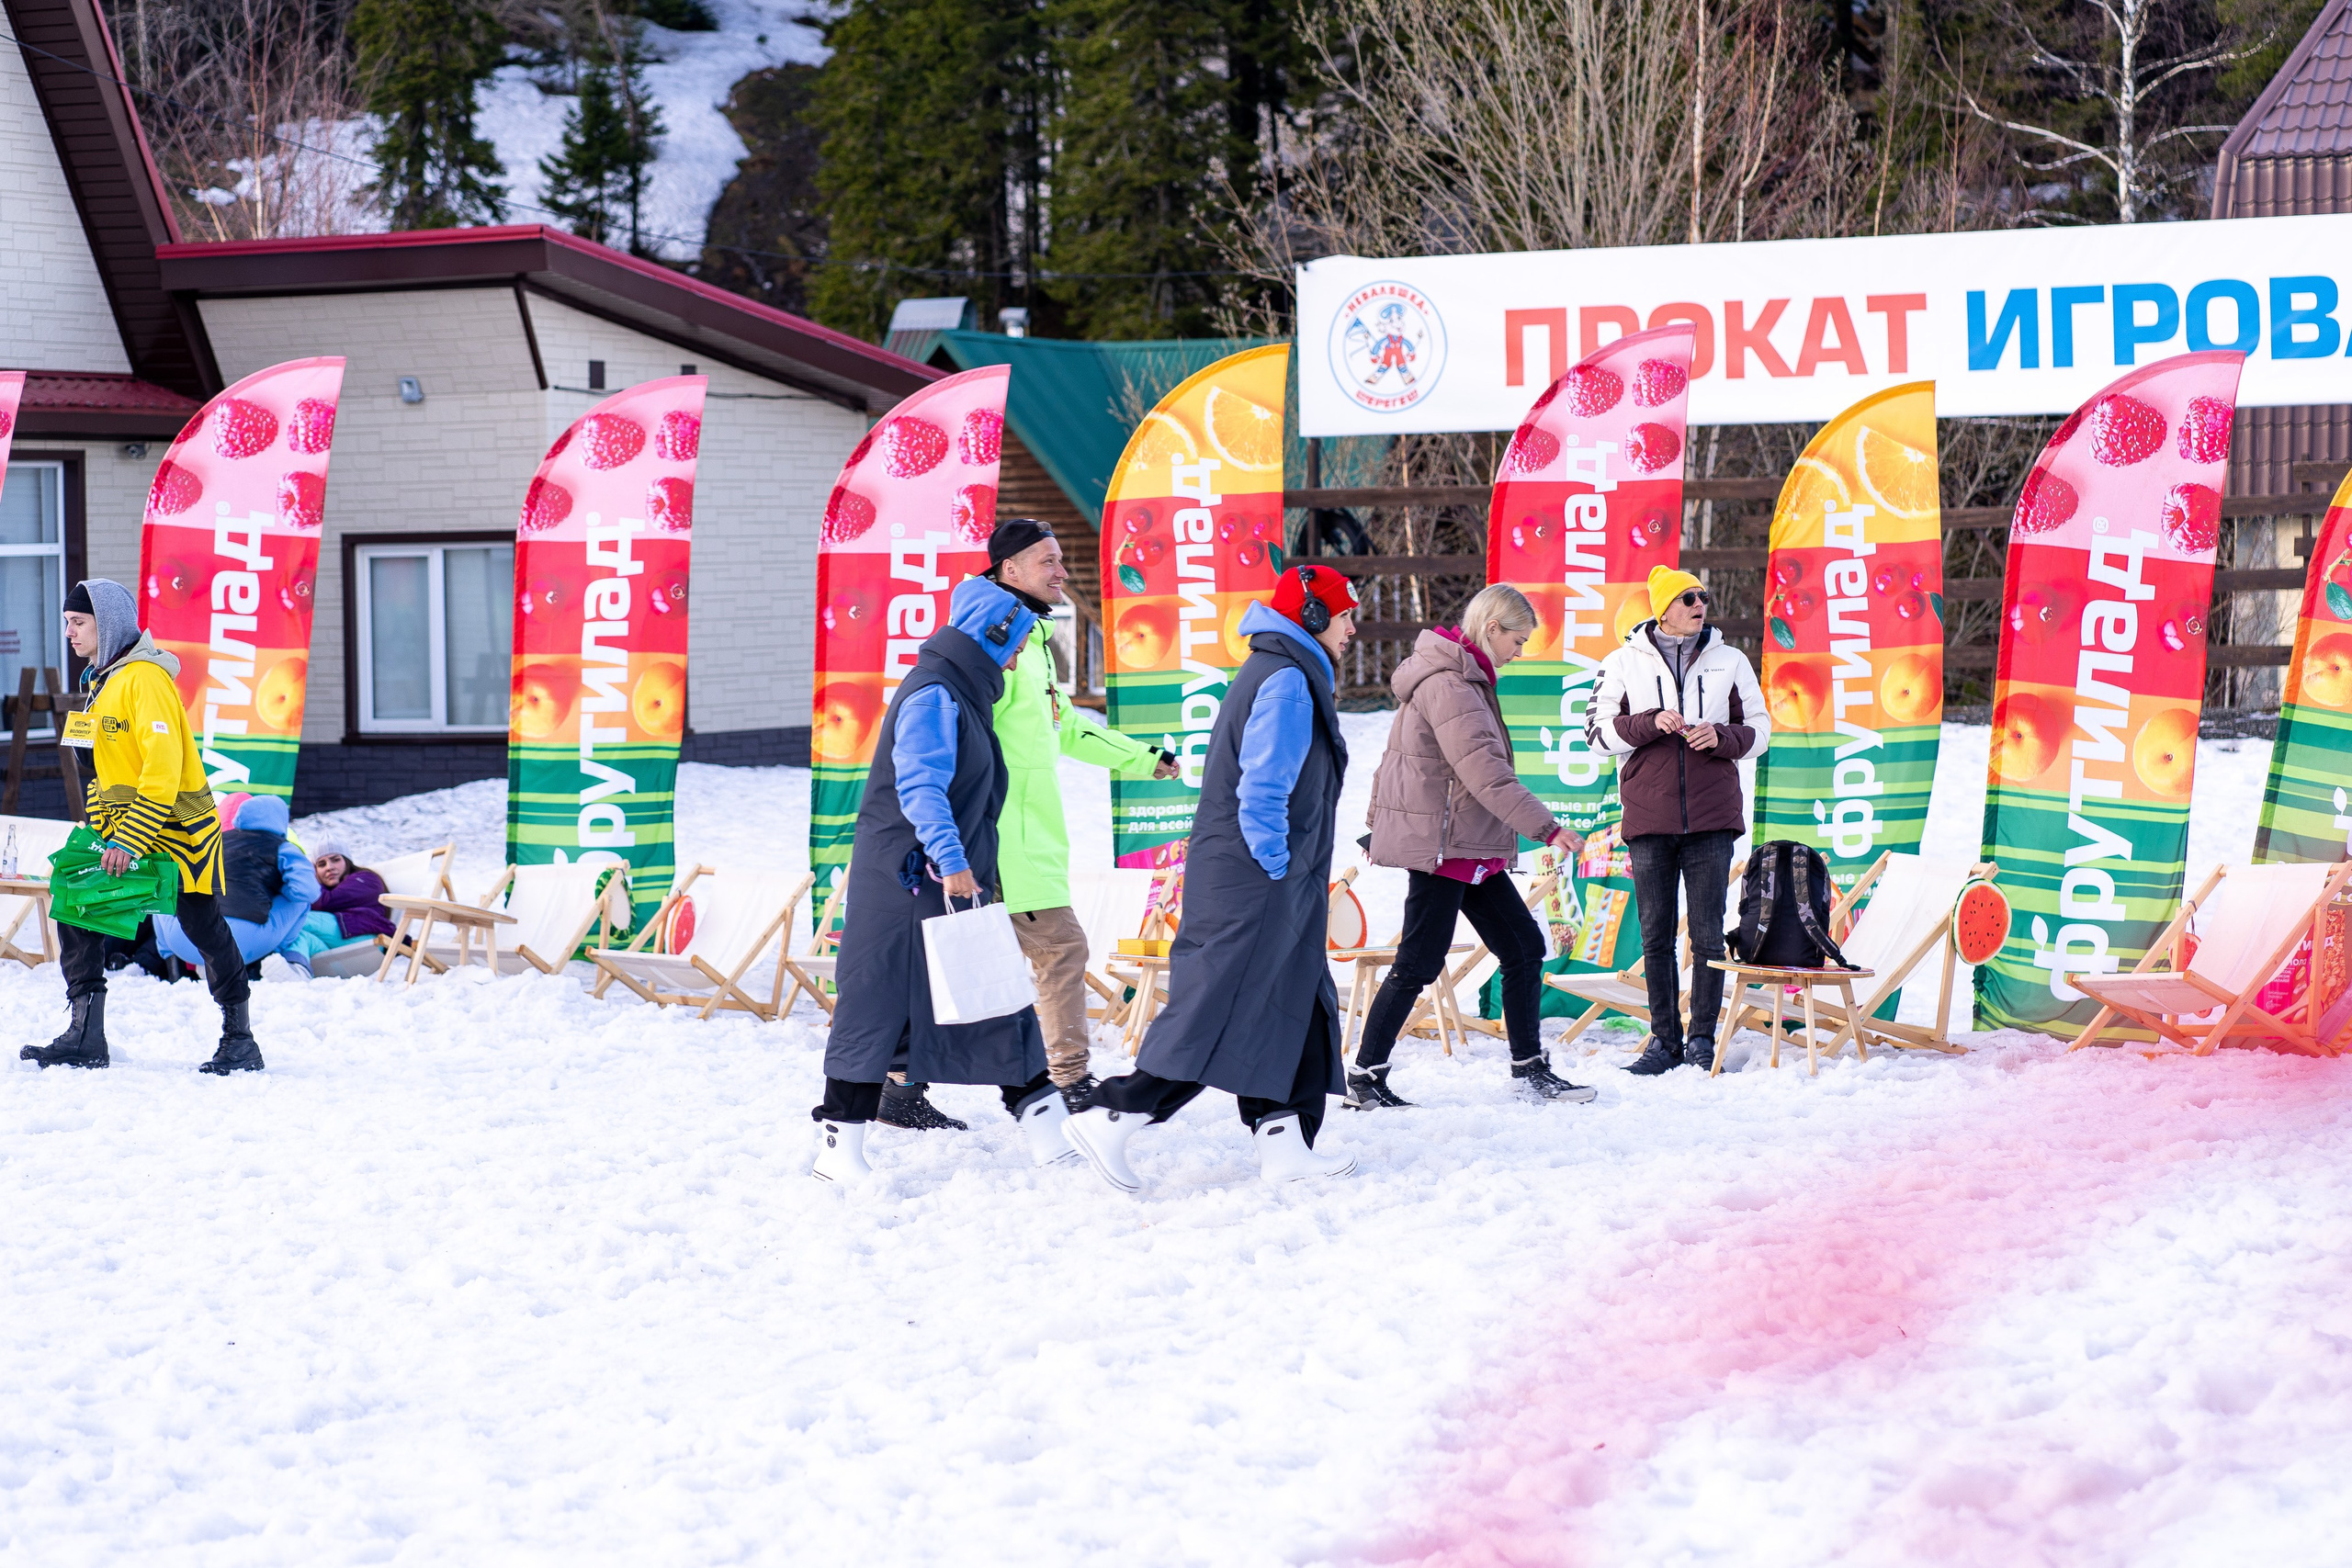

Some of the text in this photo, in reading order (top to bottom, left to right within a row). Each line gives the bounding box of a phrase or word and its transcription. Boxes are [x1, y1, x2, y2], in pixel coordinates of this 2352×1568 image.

[1505, 276, 2352, 387] ПРОКАТ ИГРОВ
[201, 510, 276, 797] утилад
[553, 517, 646, 863] рутилад
[1814, 503, 1884, 859] фрутилад
[2031, 528, 2160, 1002] фрутилад
[1128, 816, 1193, 834] для всей
